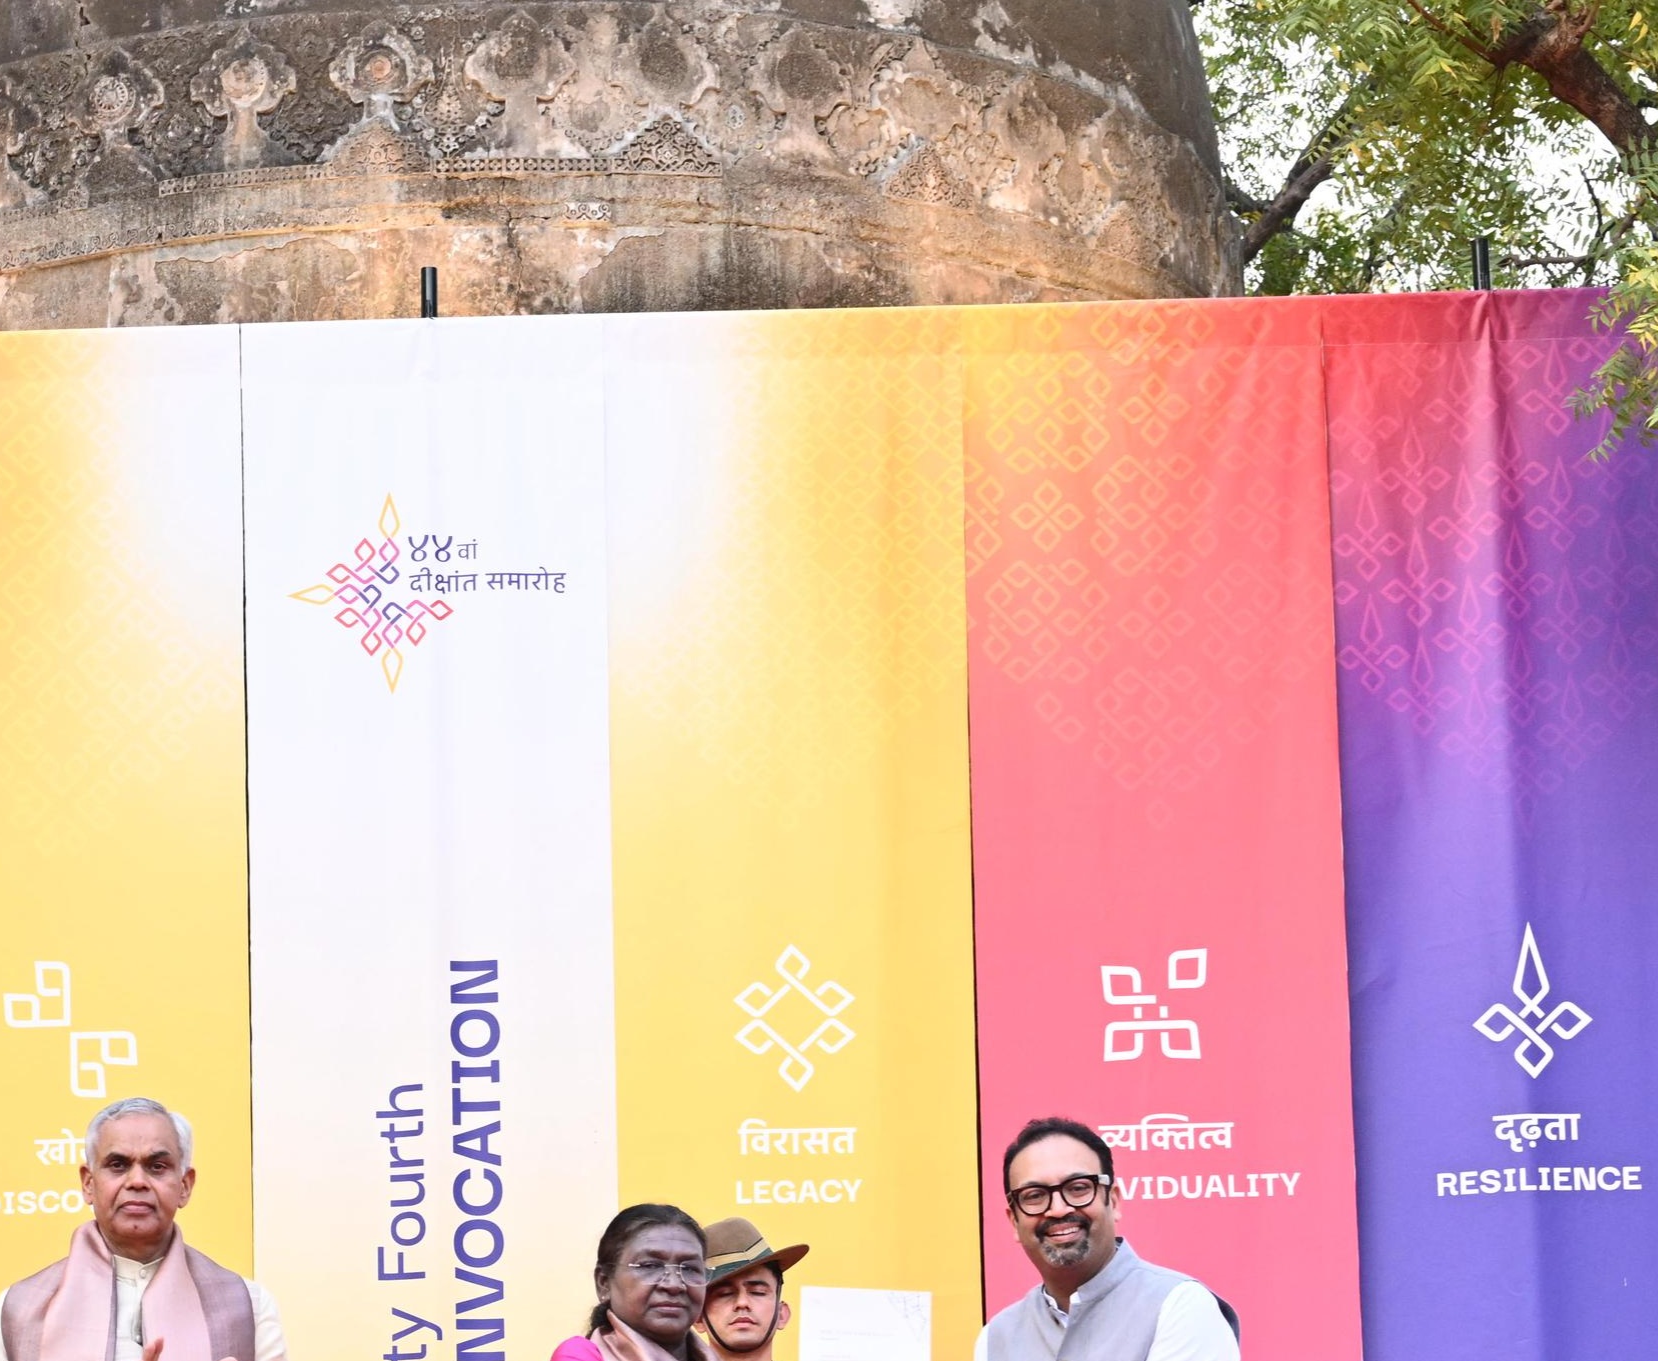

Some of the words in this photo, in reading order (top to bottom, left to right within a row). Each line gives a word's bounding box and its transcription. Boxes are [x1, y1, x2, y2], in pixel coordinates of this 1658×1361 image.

[409, 567, 478, 594] दीक्षांत
[485, 567, 567, 593] समारोह
[33, 1128, 87, 1165] खो
[737, 1119, 857, 1154] विरासत
[1098, 1113, 1235, 1151] व्यक्तित्व
[1492, 1112, 1581, 1152] दृढ़ता
[375, 1083, 427, 1281] Fourth
[735, 1179, 862, 1204] LEGACY
[1116, 1172, 1301, 1200] VIDUALITY
[1436, 1166, 1643, 1197] RESILIENCE
